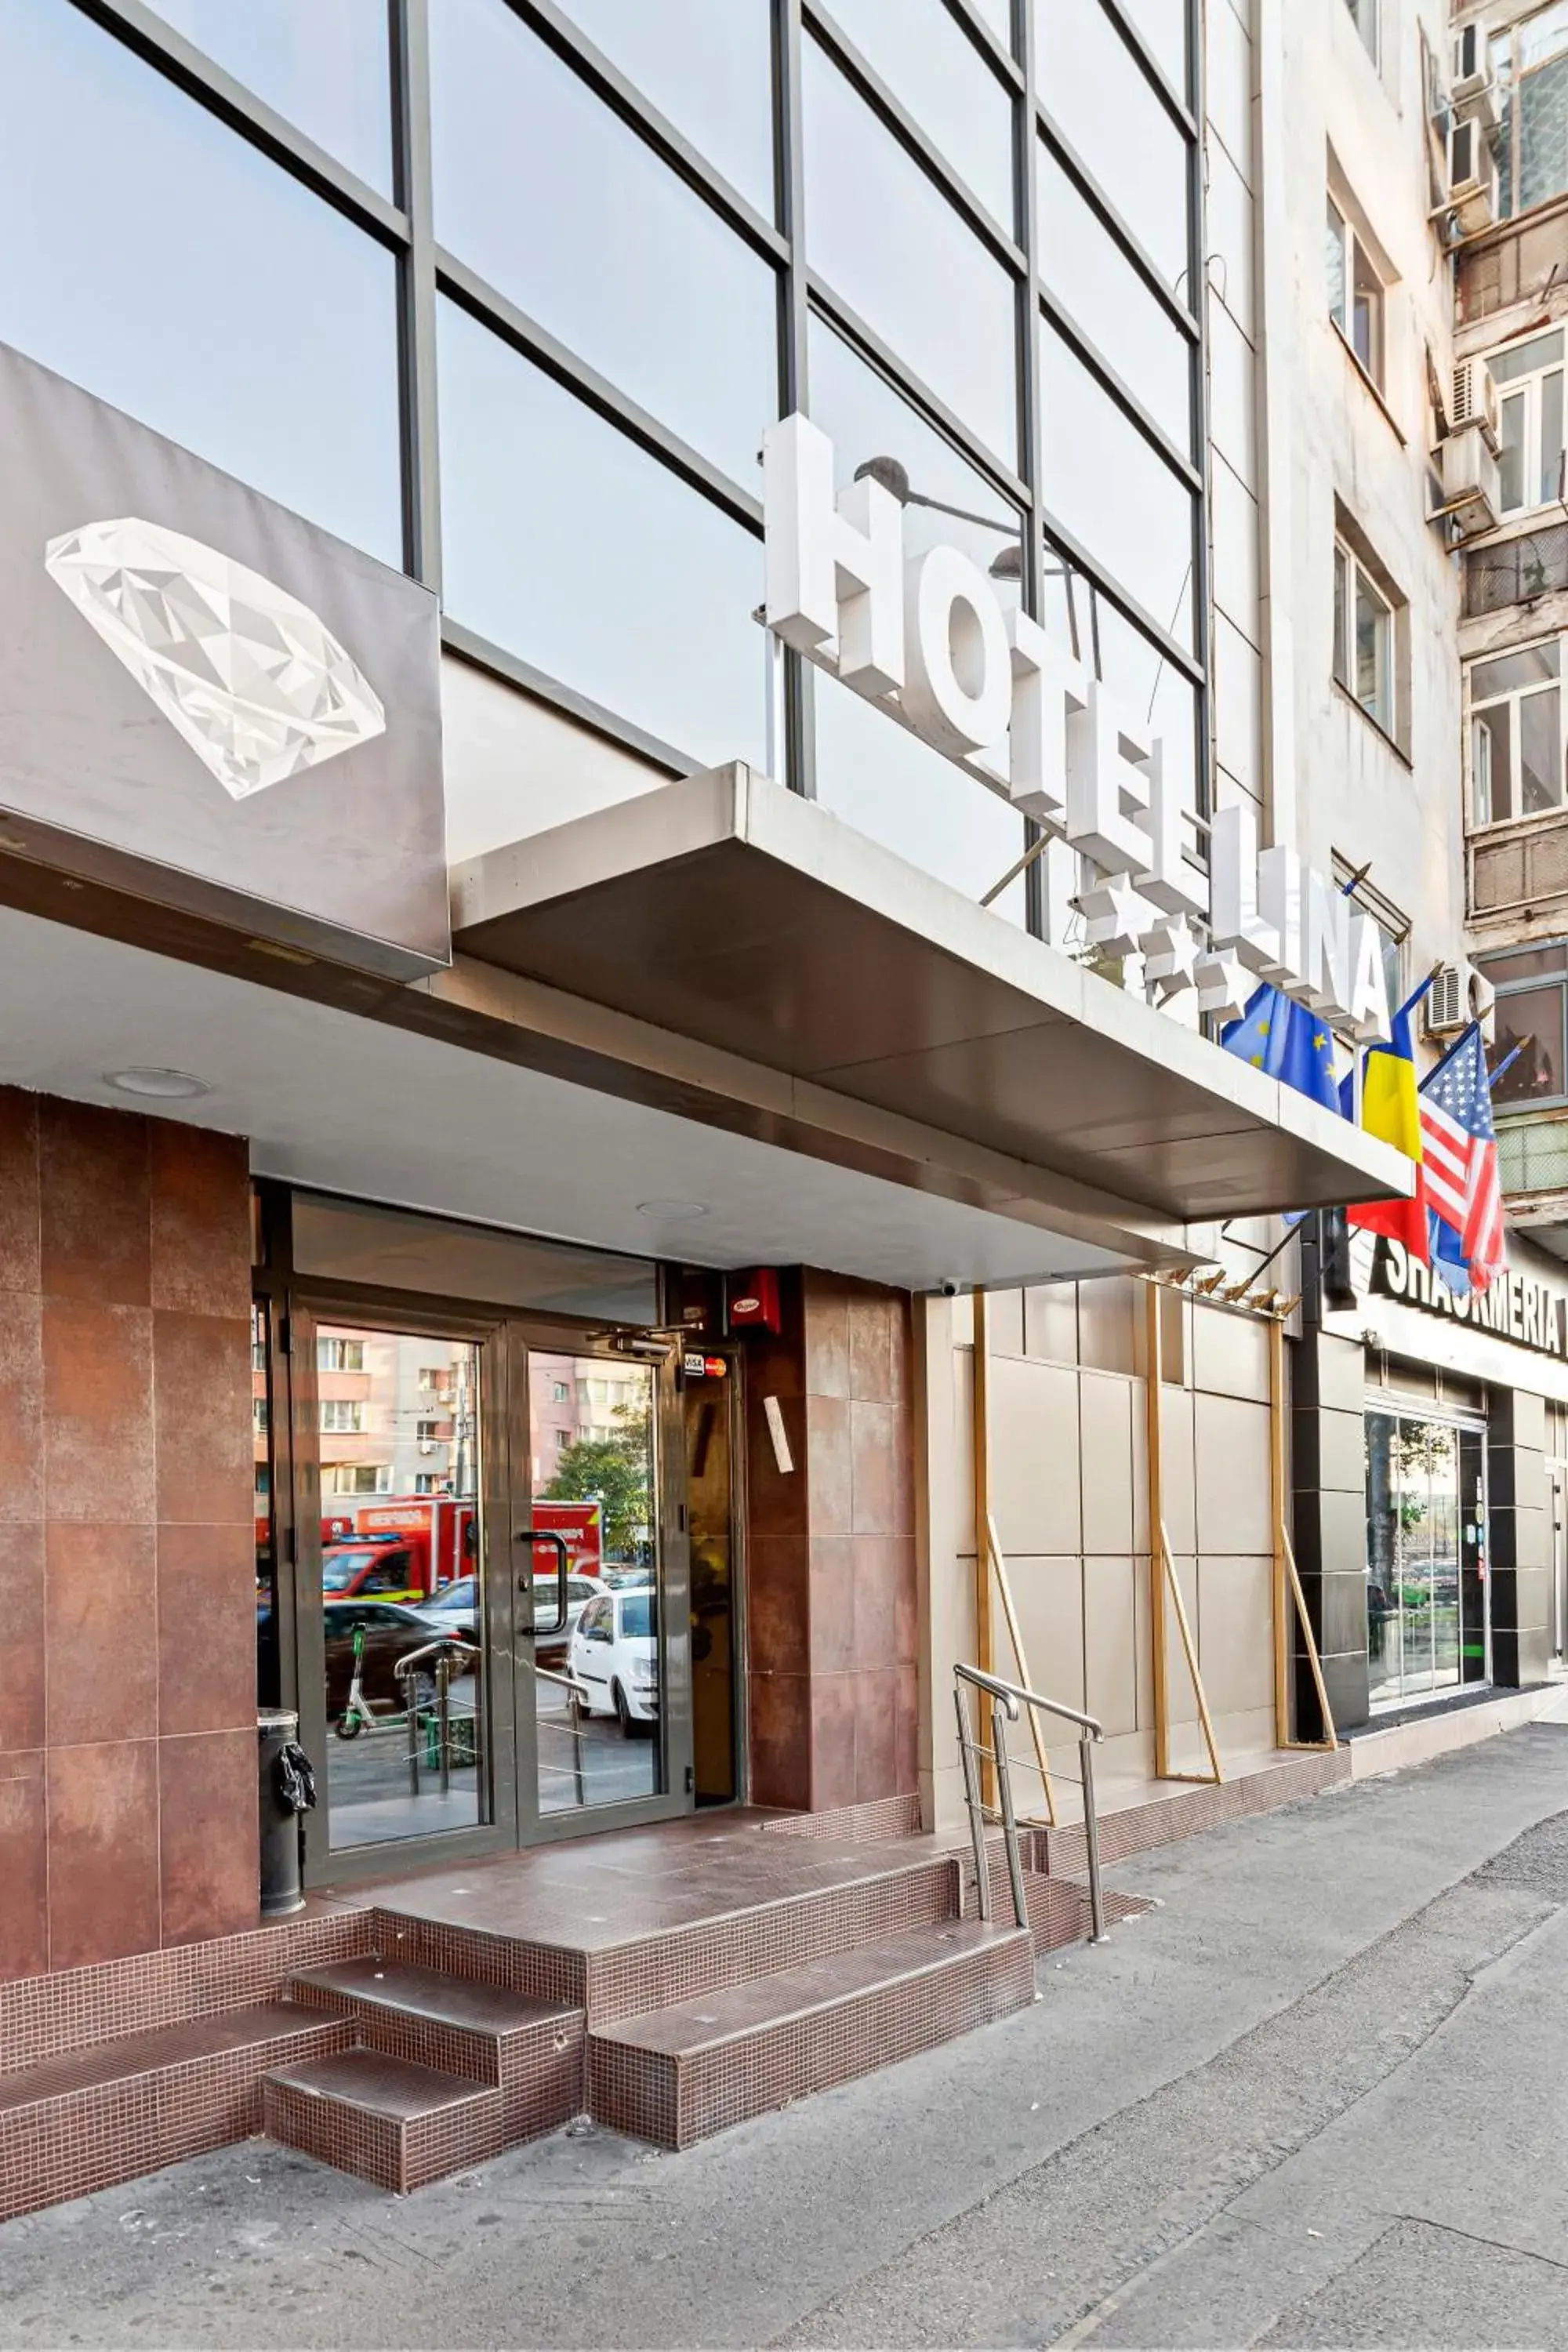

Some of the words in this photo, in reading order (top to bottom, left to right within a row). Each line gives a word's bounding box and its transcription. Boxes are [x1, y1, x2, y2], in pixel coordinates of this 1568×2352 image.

[763, 412, 1211, 915] HOTEL
[1211, 805, 1393, 1044] LINA
[686, 1357, 702, 1367] VISA
